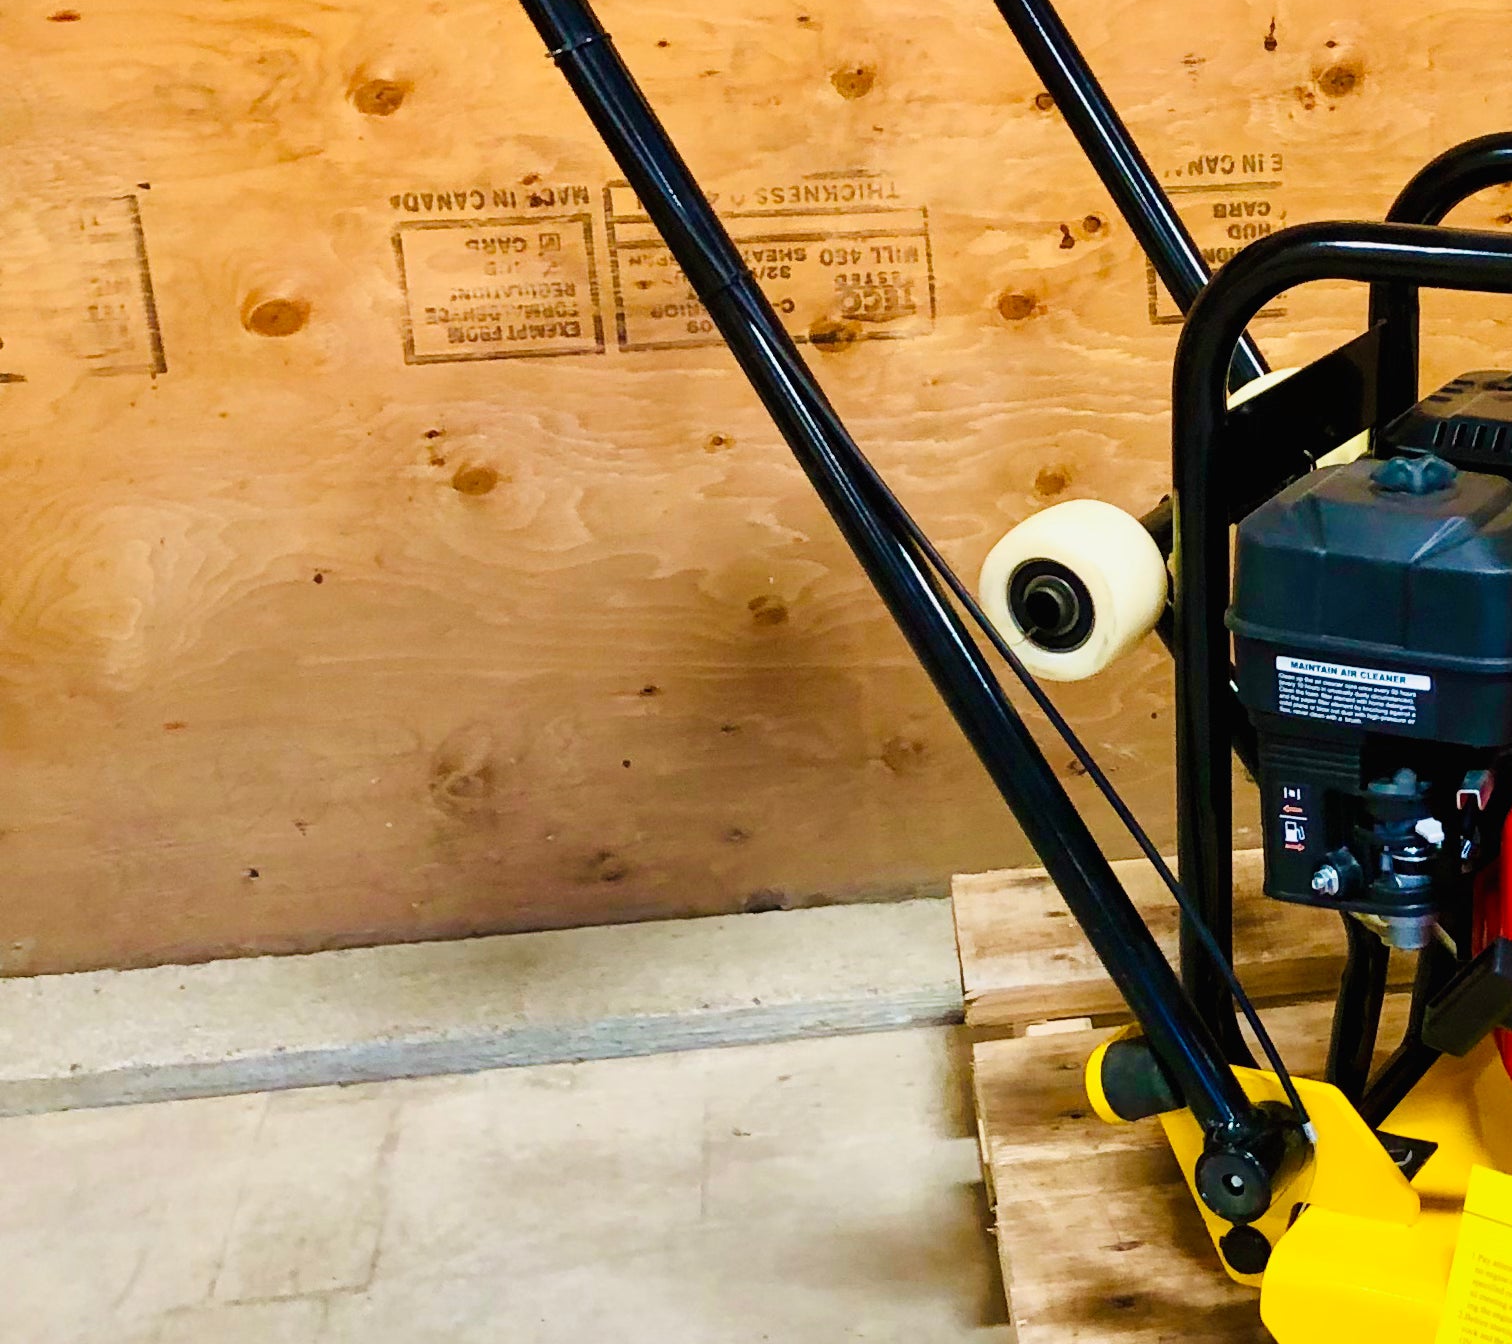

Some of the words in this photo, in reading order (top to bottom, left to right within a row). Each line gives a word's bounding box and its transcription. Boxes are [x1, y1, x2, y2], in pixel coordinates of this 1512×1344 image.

[752, 182, 900, 205] THICKNESS
[1213, 202, 1271, 218] CARB
[1290, 661, 1338, 675] MAINTAIN
[1341, 668, 1357, 678] AIR
[1360, 671, 1406, 684] CLEANER
